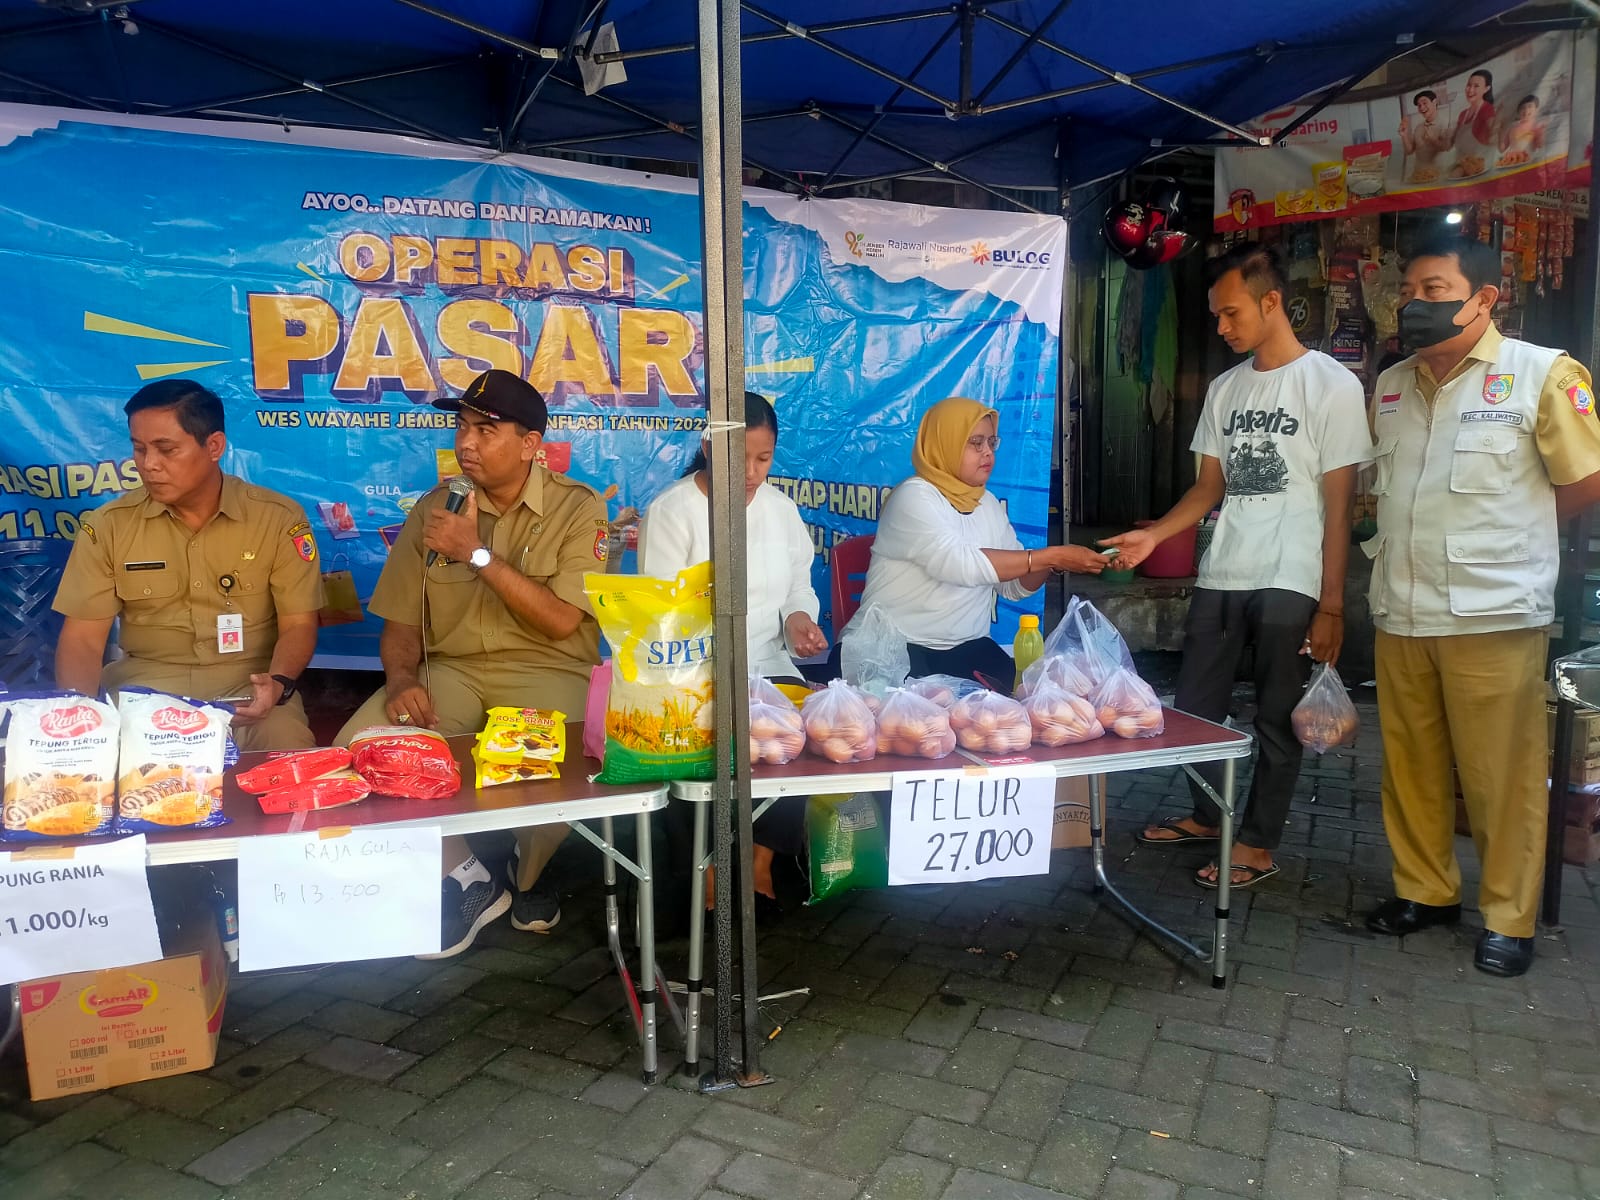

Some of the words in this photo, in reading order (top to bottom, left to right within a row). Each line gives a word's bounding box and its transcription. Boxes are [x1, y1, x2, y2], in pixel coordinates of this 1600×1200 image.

[383, 196, 476, 219] DATANG
[479, 202, 527, 222] DAN
[887, 239, 927, 251] Rajawali
[929, 242, 967, 255] Nusindo
[992, 249, 1051, 265] BULOG
[339, 232, 629, 295] OPERASI
[246, 292, 700, 398] PASAR
[1333, 338, 1361, 348] KING
[256, 411, 301, 428] WES
[305, 412, 391, 428] WAYAHE
[395, 412, 458, 429] JEMBE
[546, 415, 605, 430] NFLASI
[607, 415, 669, 431] TAHUN
[673, 416, 708, 432] 202
[1222, 407, 1299, 437] Jakarta
[66, 459, 145, 498] PAS
[364, 485, 401, 496] GULA
[829, 482, 878, 521] HARI
[0, 509, 93, 541] 11.0
[647, 635, 714, 665] SPH
[47, 706, 95, 731] Rania
[495, 715, 521, 723] ROSE
[524, 716, 556, 727] BRAND
[29, 738, 70, 748] TEPUNG
[73, 737, 108, 747] TERIGU
[144, 732, 180, 741] TEPUNG
[183, 731, 216, 742] TERIGU
[664, 733, 674, 747] 5
[905, 776, 1021, 822] TELUR
[1055, 809, 1090, 822] NYAKIT
[304, 842, 352, 863] RAJA
[361, 839, 412, 857] GULA
[923, 827, 1034, 873] 27.000
[49, 864, 105, 883] RANIA
[0, 907, 109, 936] 1.000/kg
[149, 1025, 168, 1034] Liter
[168, 1048, 186, 1056] Liter
[74, 1065, 94, 1073] Liter
